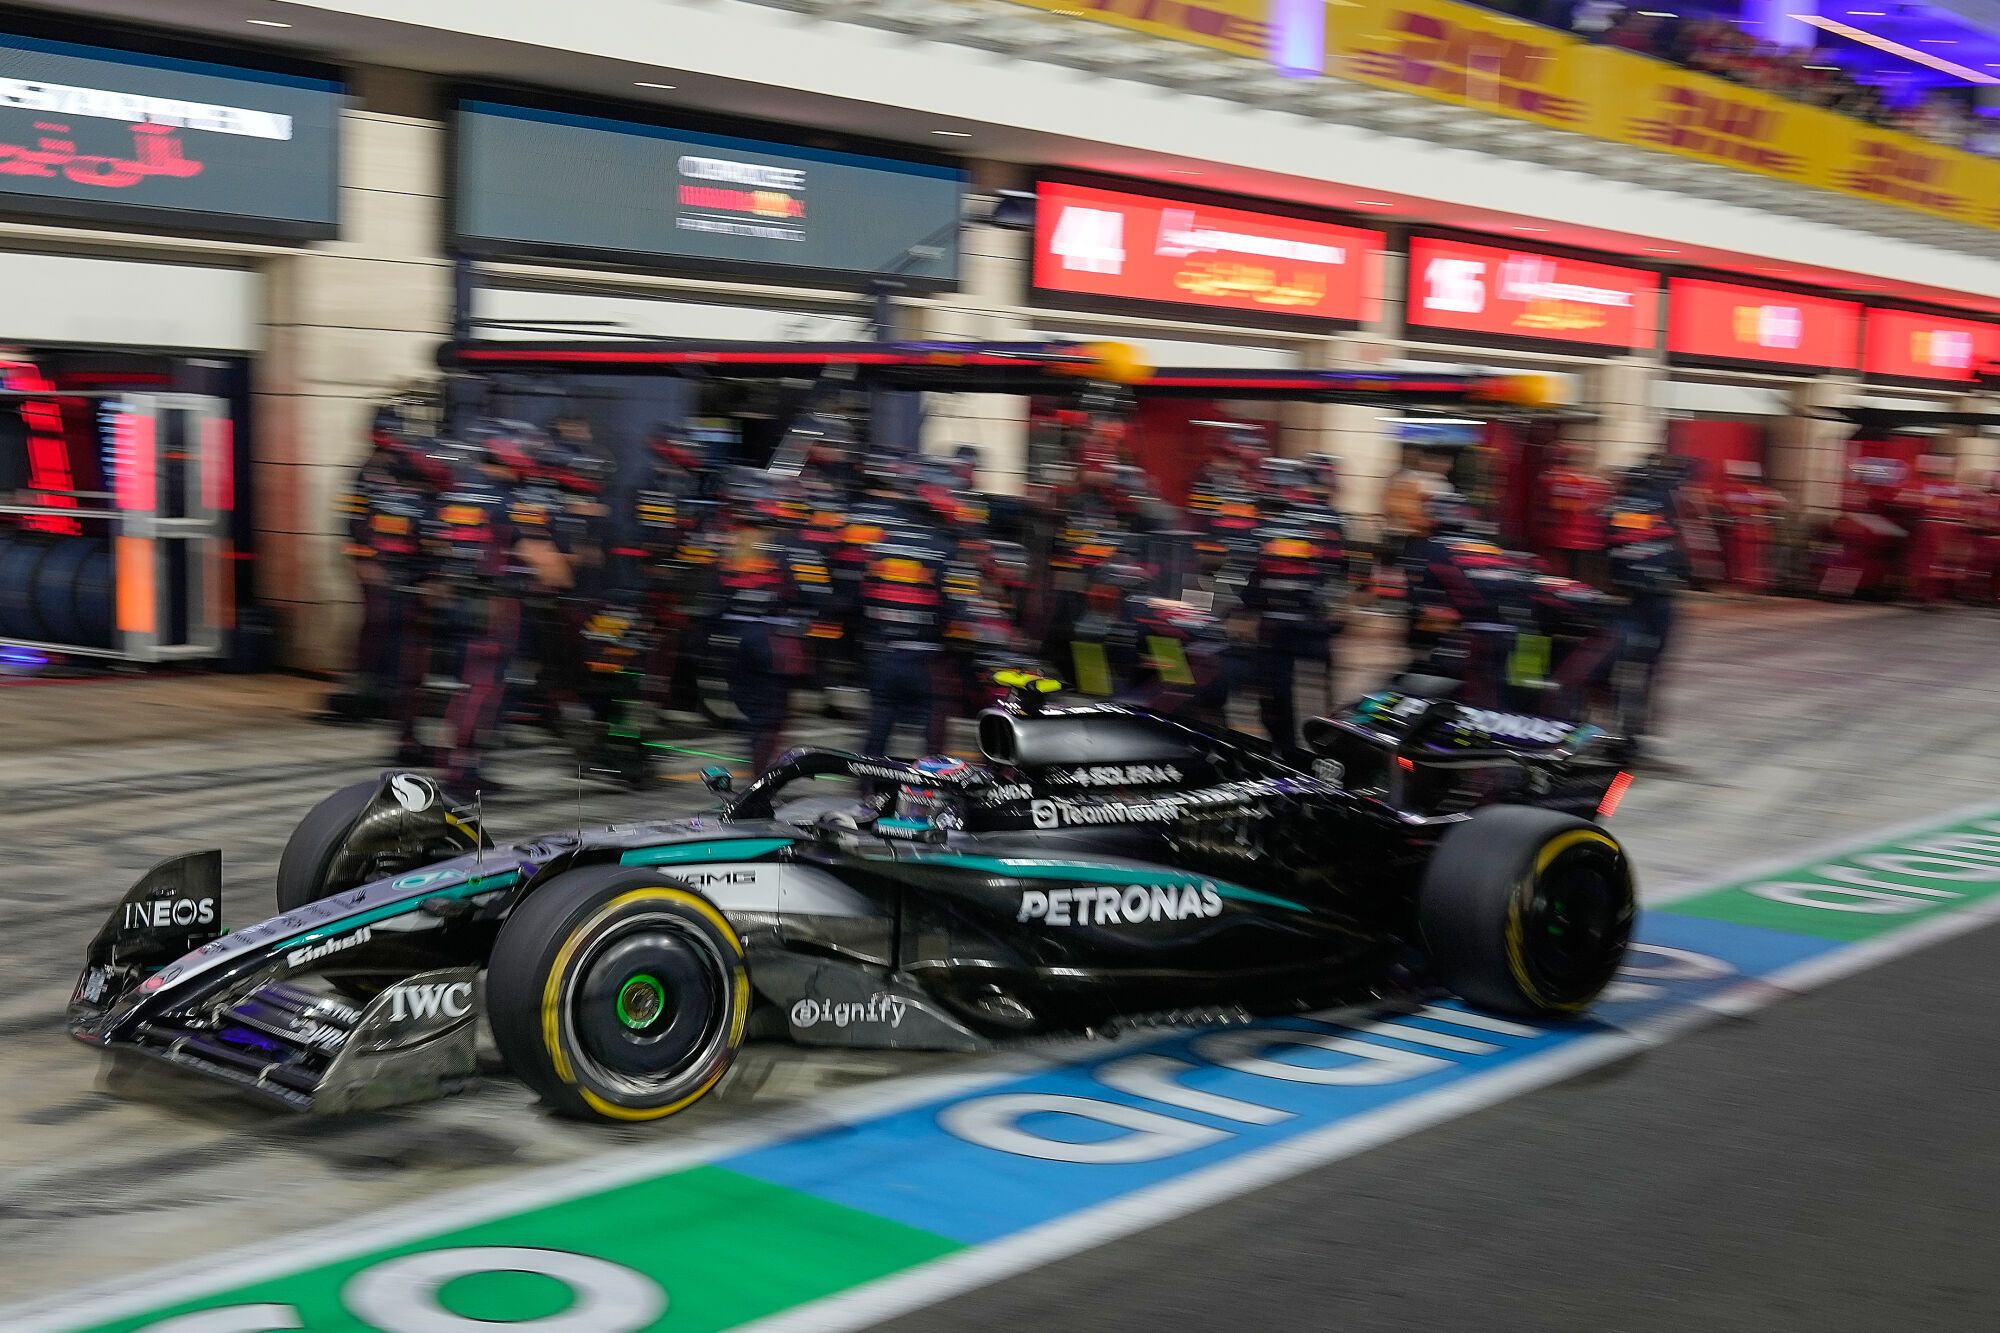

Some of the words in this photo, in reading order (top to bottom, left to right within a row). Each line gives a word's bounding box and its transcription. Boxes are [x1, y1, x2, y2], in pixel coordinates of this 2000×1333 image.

[124, 897, 214, 930] INEOS
[1016, 880, 1223, 926] PETRONAS
[286, 925, 372, 968] Einhell
[388, 981, 473, 1023] IWC
